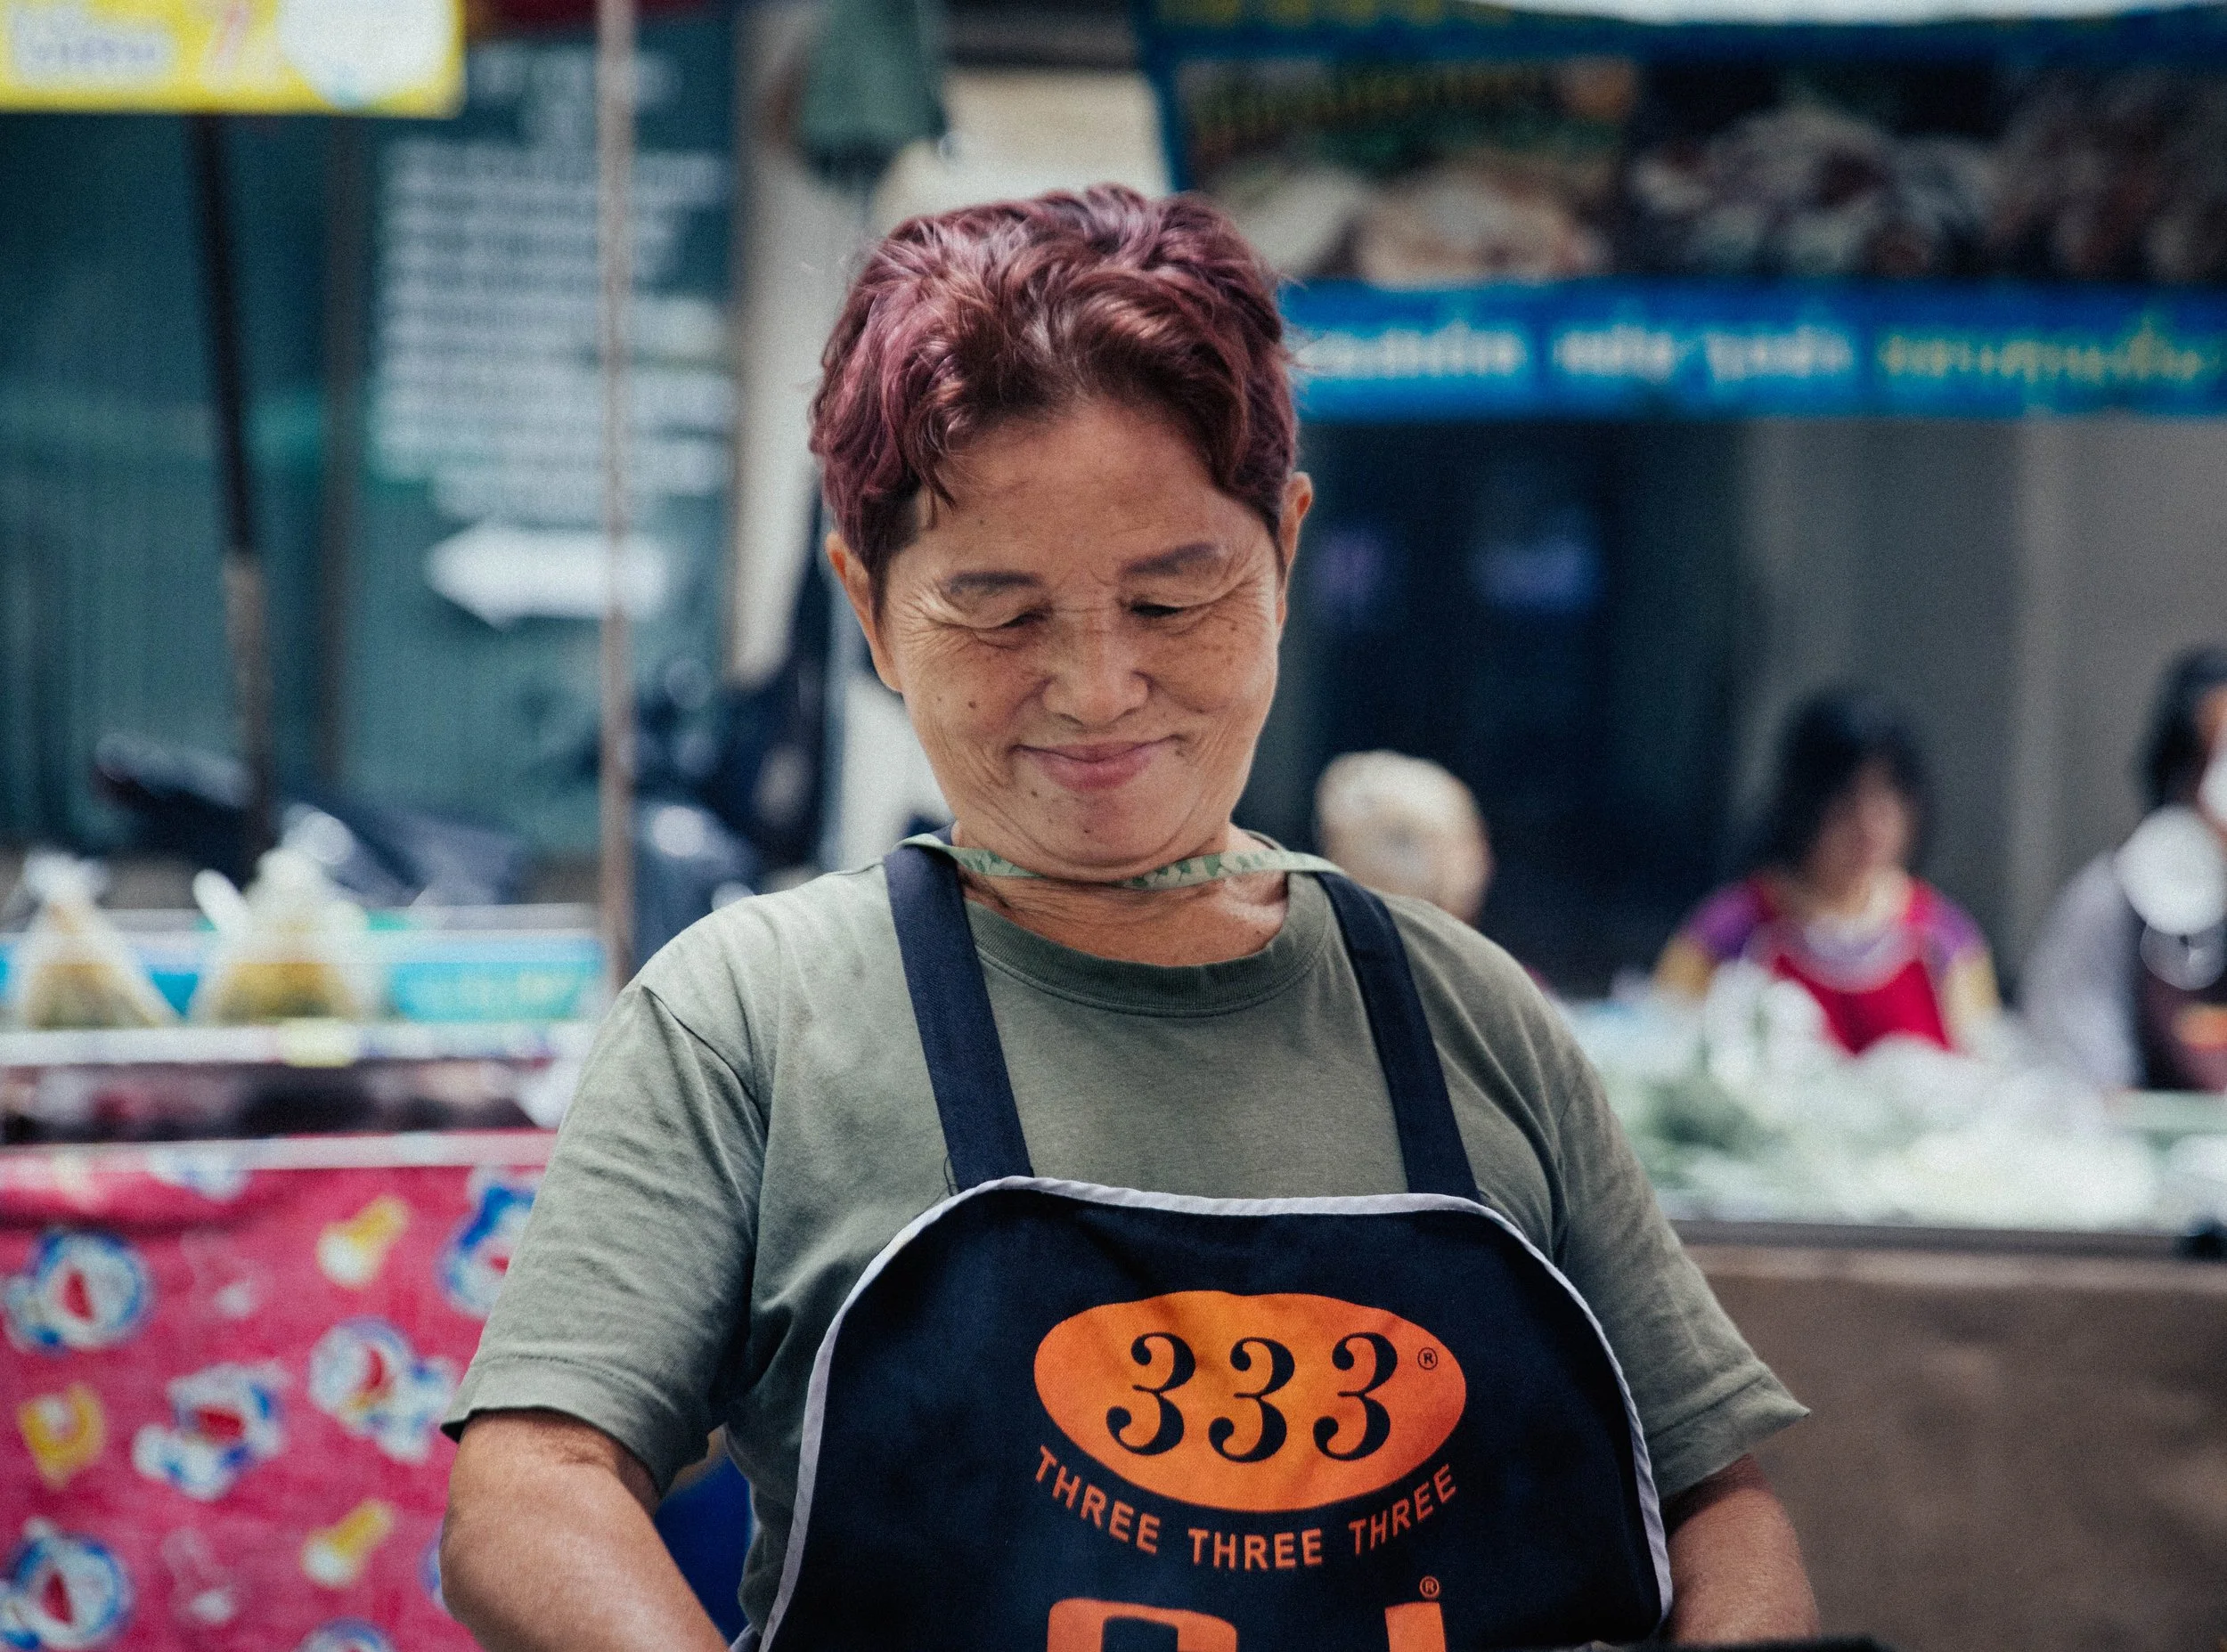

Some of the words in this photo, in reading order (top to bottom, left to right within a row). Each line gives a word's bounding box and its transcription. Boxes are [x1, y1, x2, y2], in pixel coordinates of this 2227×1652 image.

[1105, 1331, 1398, 1462] 333
[1034, 1445, 1161, 1554] THREE
[1187, 1528, 1324, 1570] THREE
[1348, 1464, 1457, 1555] THREE
